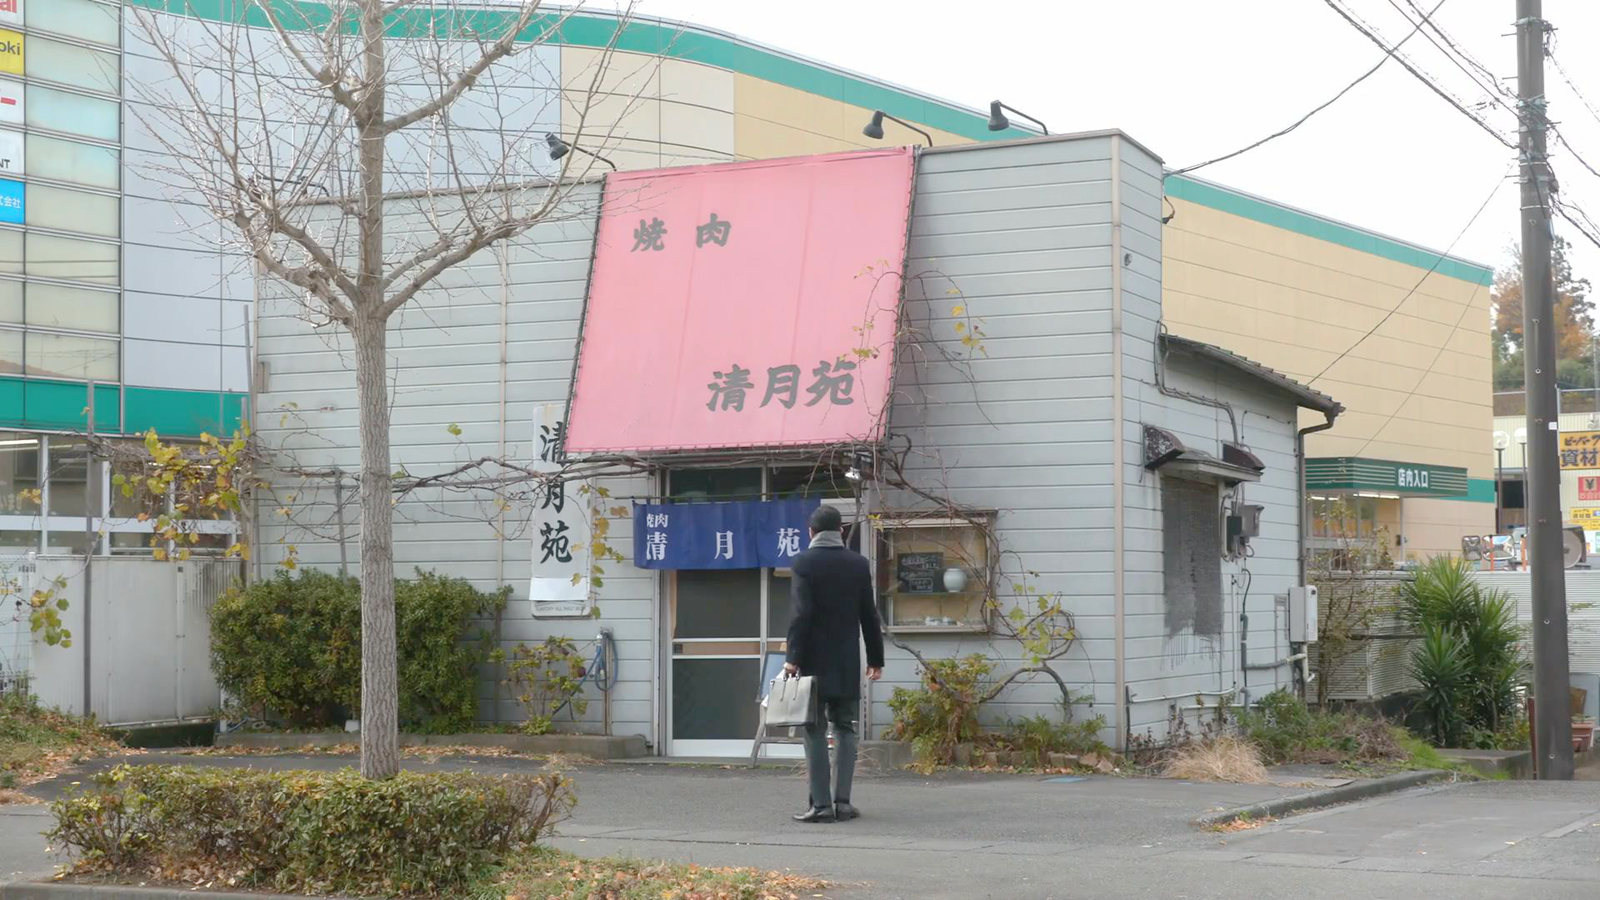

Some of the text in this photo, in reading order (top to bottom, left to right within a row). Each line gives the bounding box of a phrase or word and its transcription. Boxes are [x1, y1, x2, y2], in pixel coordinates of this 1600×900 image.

[630, 213, 732, 253] 焼肉
[706, 359, 857, 413] 清月苑
[540, 421, 573, 564] 清月苑
[1398, 468, 1429, 488] 店内入口
